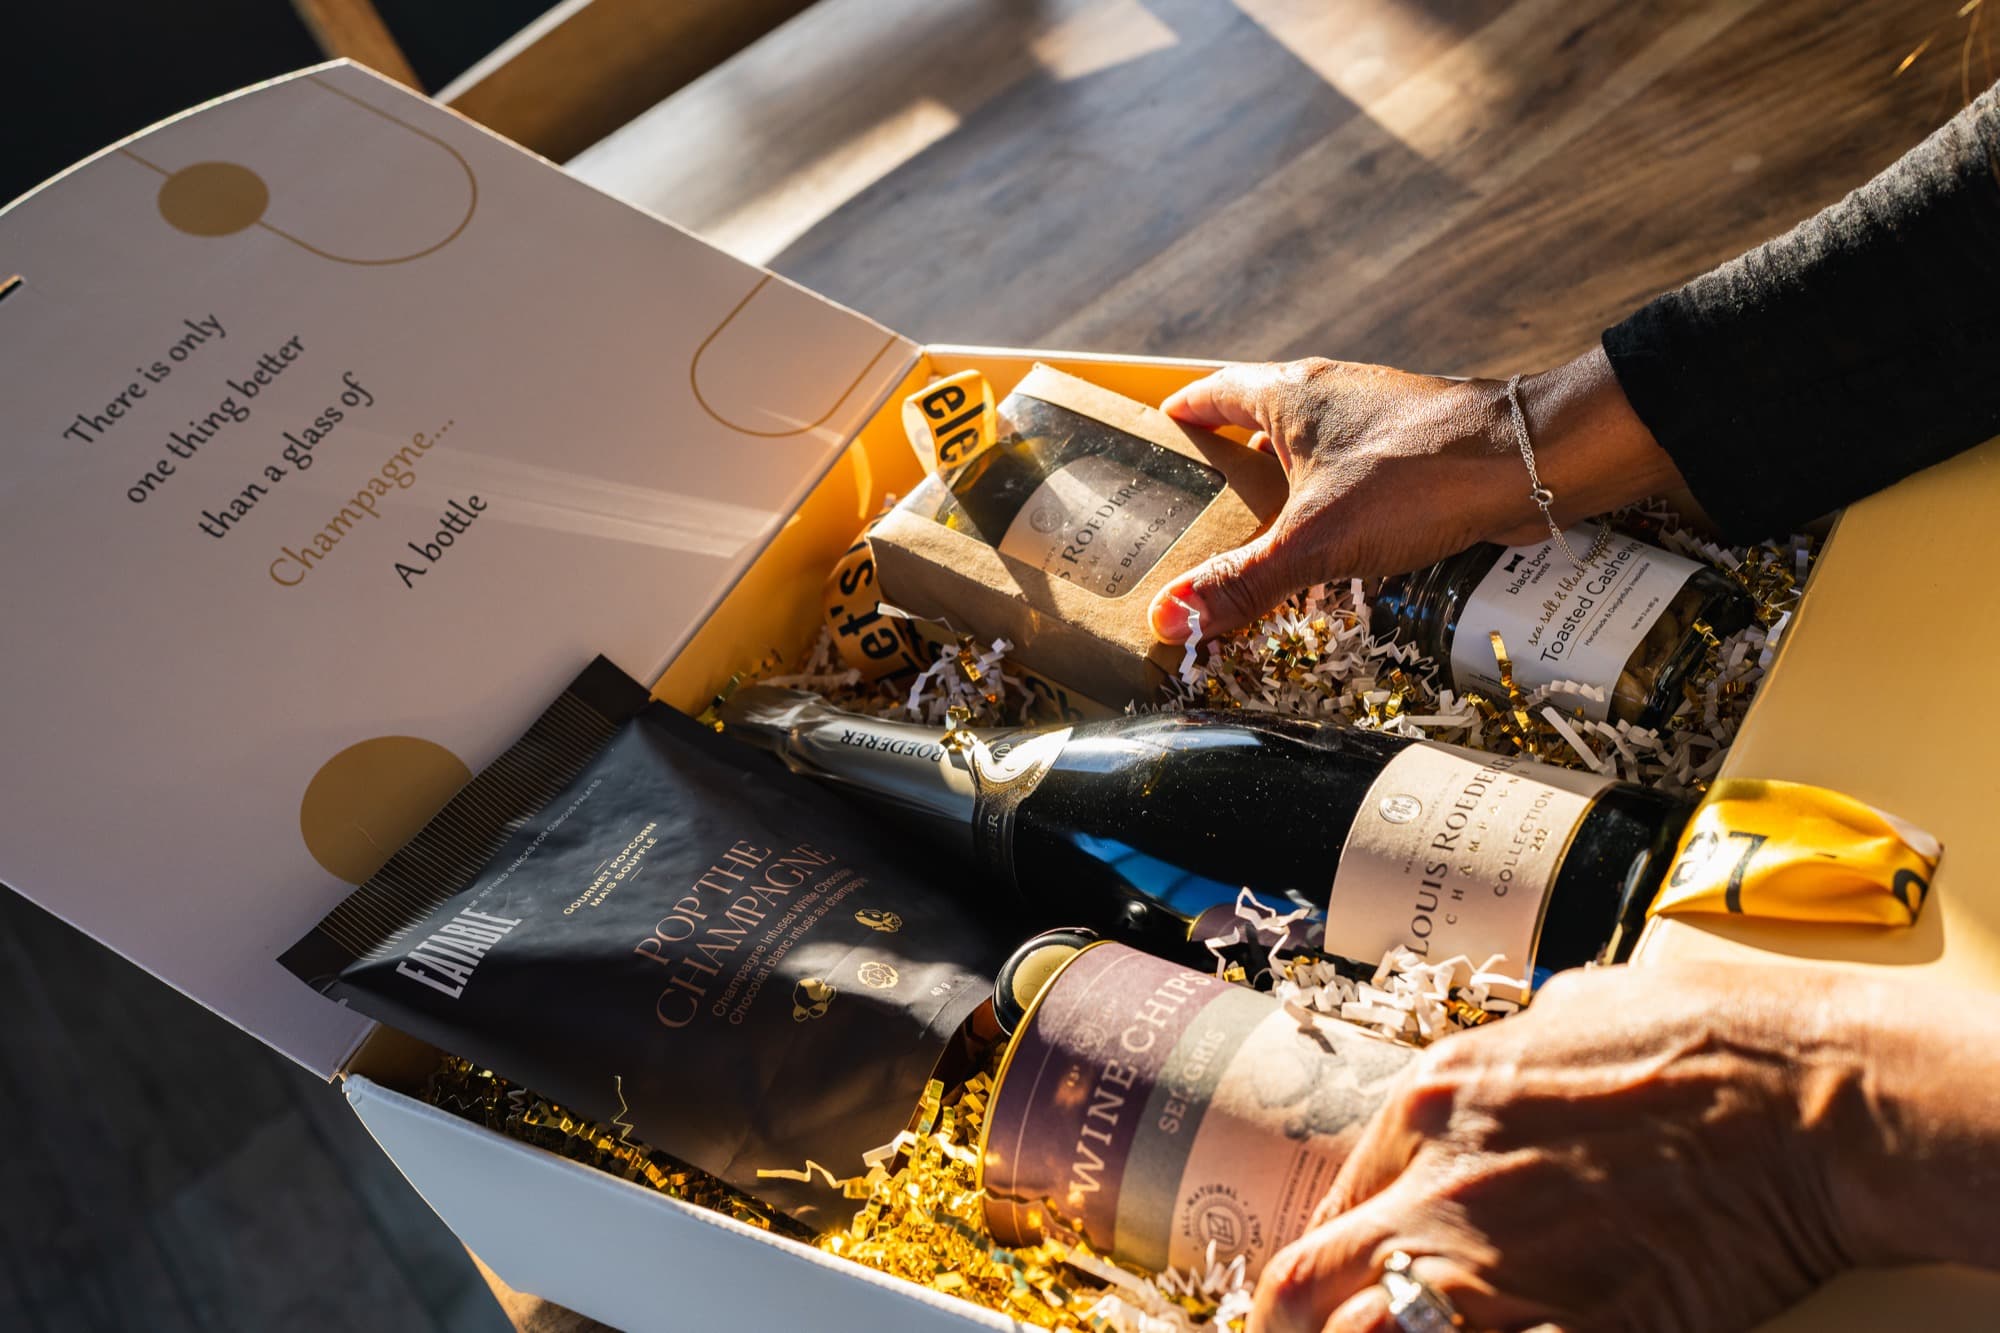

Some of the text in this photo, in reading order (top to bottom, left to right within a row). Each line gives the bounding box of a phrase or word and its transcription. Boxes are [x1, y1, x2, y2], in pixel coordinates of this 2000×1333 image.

[63, 314, 227, 444] There is only
[127, 335, 306, 504] one thing better
[199, 371, 375, 539] than a glass of
[393, 492, 488, 589] A bottle
[1120, 518, 1166, 568] BLANCS
[1506, 545, 1552, 595] black bow
[1531, 562, 1551, 584] sweets
[1528, 624, 1544, 646] sea
[1540, 600, 1560, 624] salt
[1558, 563, 1587, 592] black
[1540, 595, 1595, 662] Toasted
[1586, 541, 1644, 595] Cashews
[840, 729, 945, 762] ROEDERER
[533, 831, 549, 846] FOR
[563, 822, 657, 915] GOURMET POPCORN
[1494, 790, 1555, 897] COLLECTION
[395, 907, 523, 1000] EATABLE
[633, 839, 773, 966] POP THE
[656, 843, 837, 1029] CHAMPAGNE
[712, 944, 767, 1016] Champagne
[761, 911, 798, 945] Infused
[791, 890, 820, 913] White
[1410, 857, 1449, 957] LOUIS
[729, 966, 771, 1024] Chocolat
[763, 939, 793, 967] blanc
[814, 905, 830, 917] au
[1070, 968, 1210, 1195] WINE CHIPS
[1158, 1030, 1226, 1134] SEL GRIS
